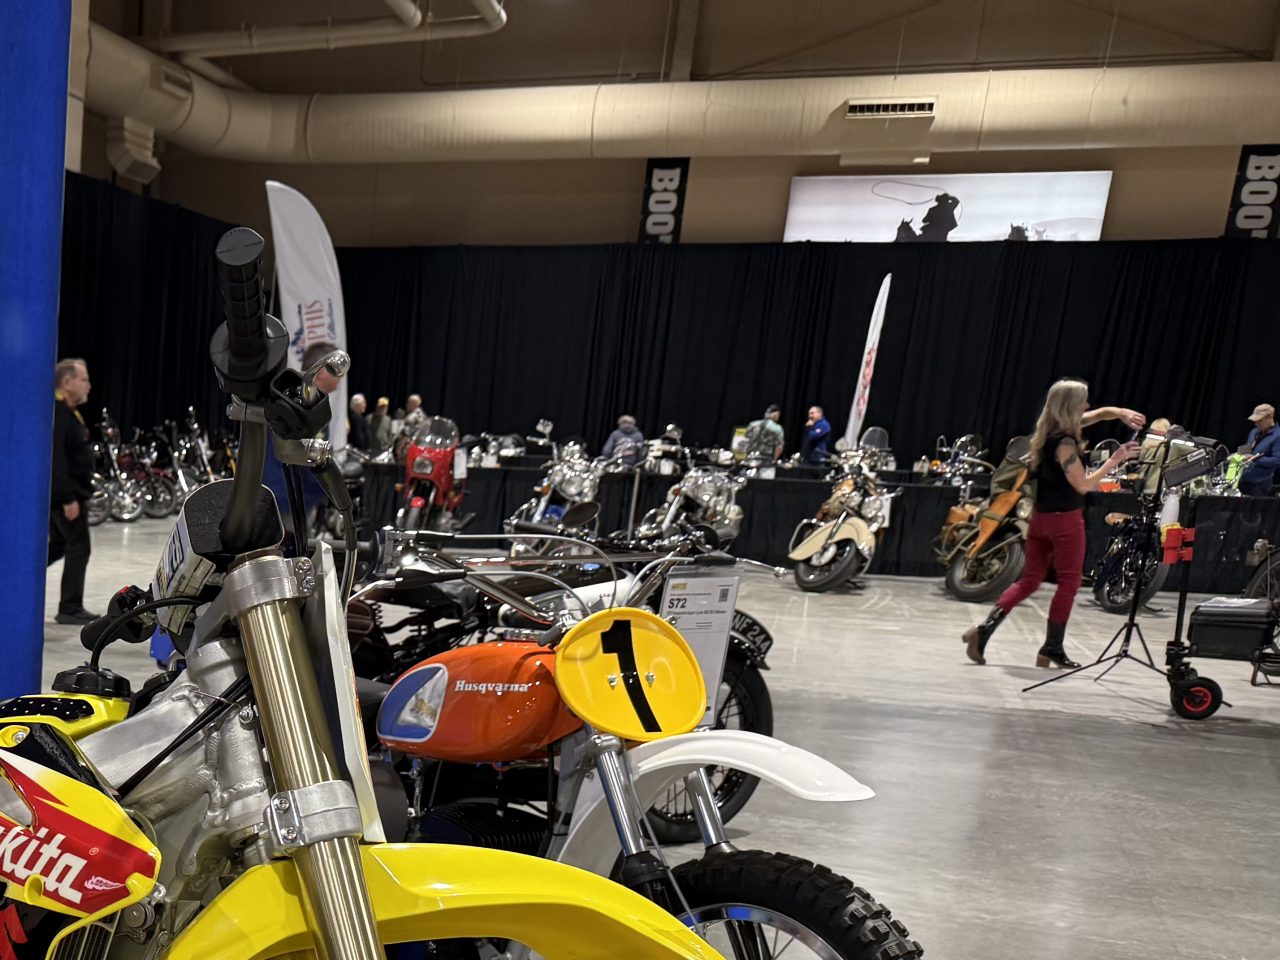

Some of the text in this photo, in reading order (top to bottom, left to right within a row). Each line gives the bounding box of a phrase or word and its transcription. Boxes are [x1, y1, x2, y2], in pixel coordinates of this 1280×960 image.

[644, 166, 682, 243] BOO
[1232, 154, 1280, 238] BOO
[668, 598, 687, 609] S72
[454, 679, 530, 694] Husqvarna
[599, 619, 663, 733] 1
